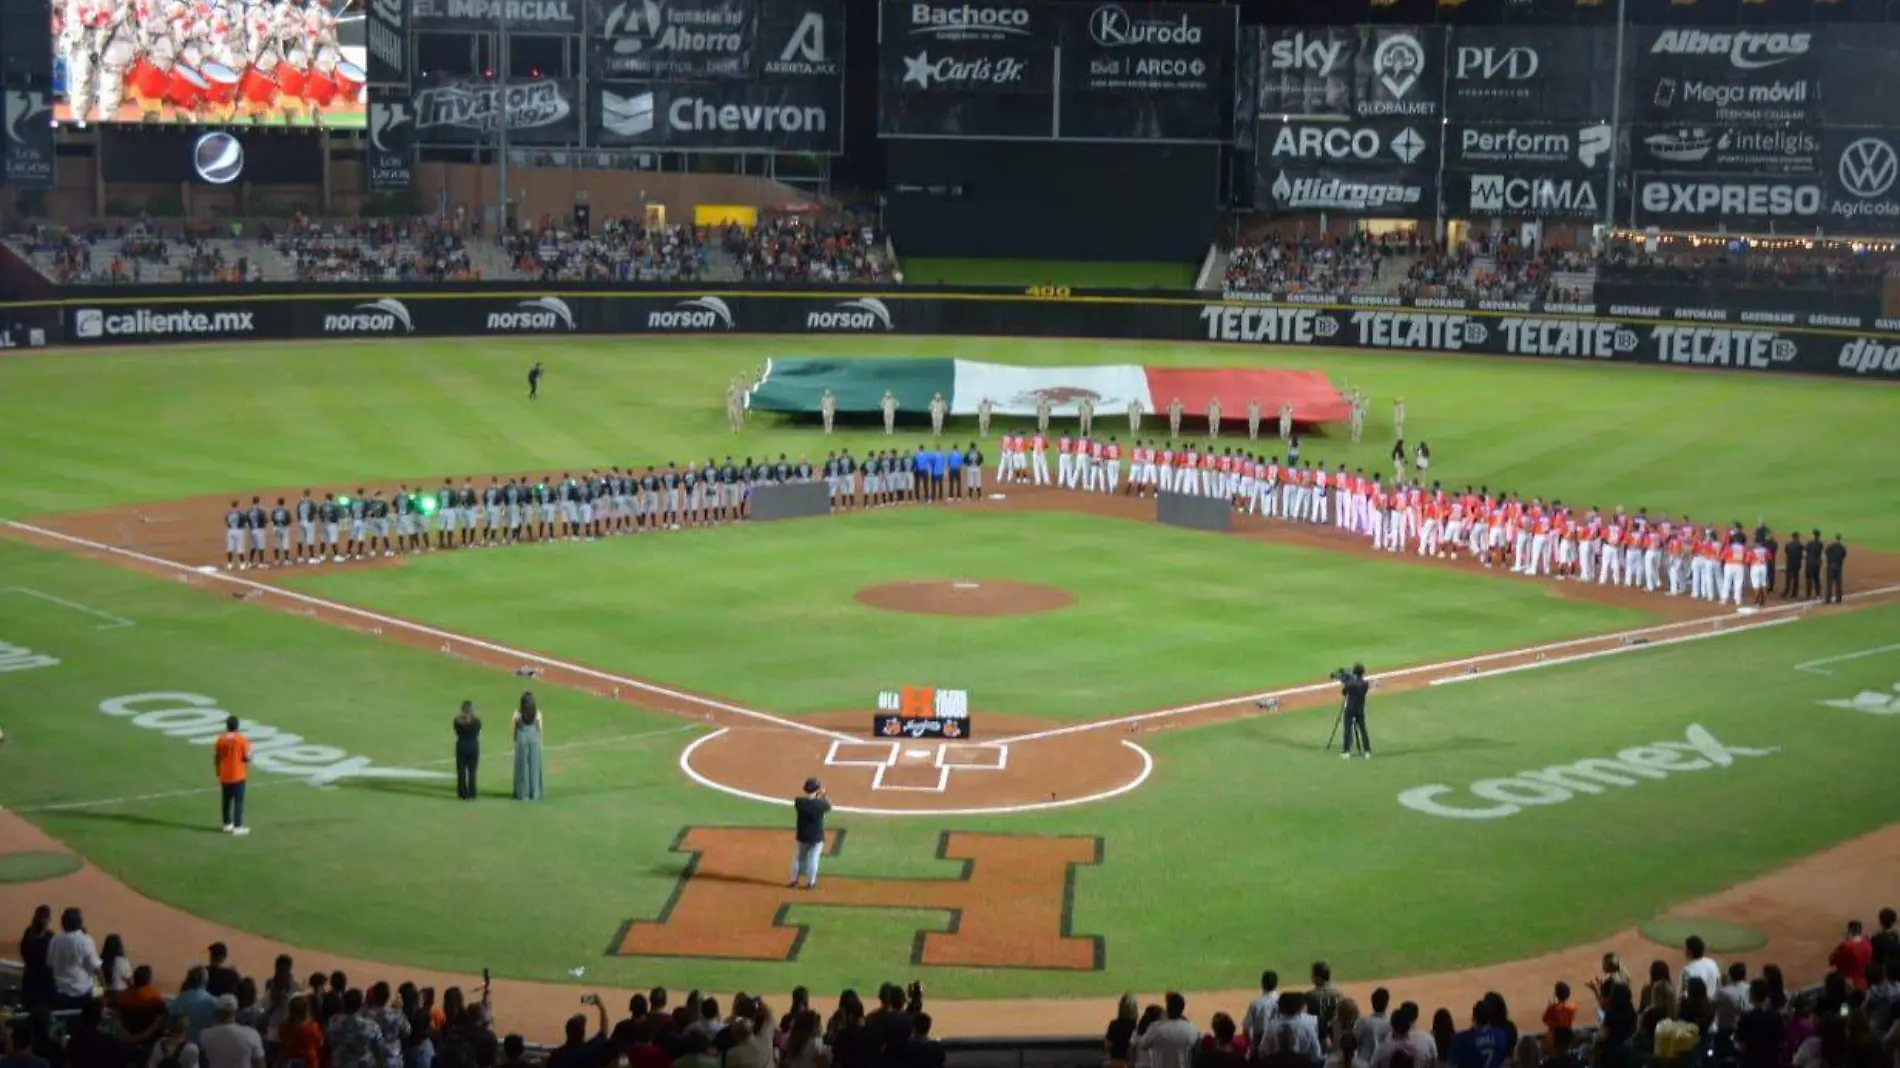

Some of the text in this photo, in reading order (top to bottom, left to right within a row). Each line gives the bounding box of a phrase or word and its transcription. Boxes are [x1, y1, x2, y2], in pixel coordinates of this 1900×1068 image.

[912, 4, 1030, 25] Bachoco
[1100, 11, 1201, 44] Kuroda
[657, 25, 743, 52] Ahorro
[1652, 29, 1812, 69] Albatros
[1135, 58, 1187, 76] ARCO
[1271, 31, 1342, 78] sky
[932, 56, 990, 82] Carl's
[1683, 80, 1806, 106] Mega móvil
[669, 98, 826, 132] Chevron
[1358, 102, 1437, 115] GLOBALMET
[1272, 127, 1380, 159] ARCO
[1462, 129, 1570, 153] Perform
[1288, 177, 1422, 208] Hidrogas
[1505, 178, 1598, 210] CIMA
[105, 310, 254, 334] caliente.mx
[324, 312, 394, 331] norson
[487, 311, 556, 329] norson
[648, 310, 715, 328] norson
[807, 310, 874, 328] norson
[1200, 305, 1321, 343] TECATE
[1675, 308, 1727, 321] GATORADE
[1808, 314, 1861, 327] GATORADE
[1350, 310, 1468, 349] TECATE
[1499, 317, 1621, 358] TECATE
[1650, 325, 1779, 367] TECATE
[1398, 723, 1780, 819] Comex
